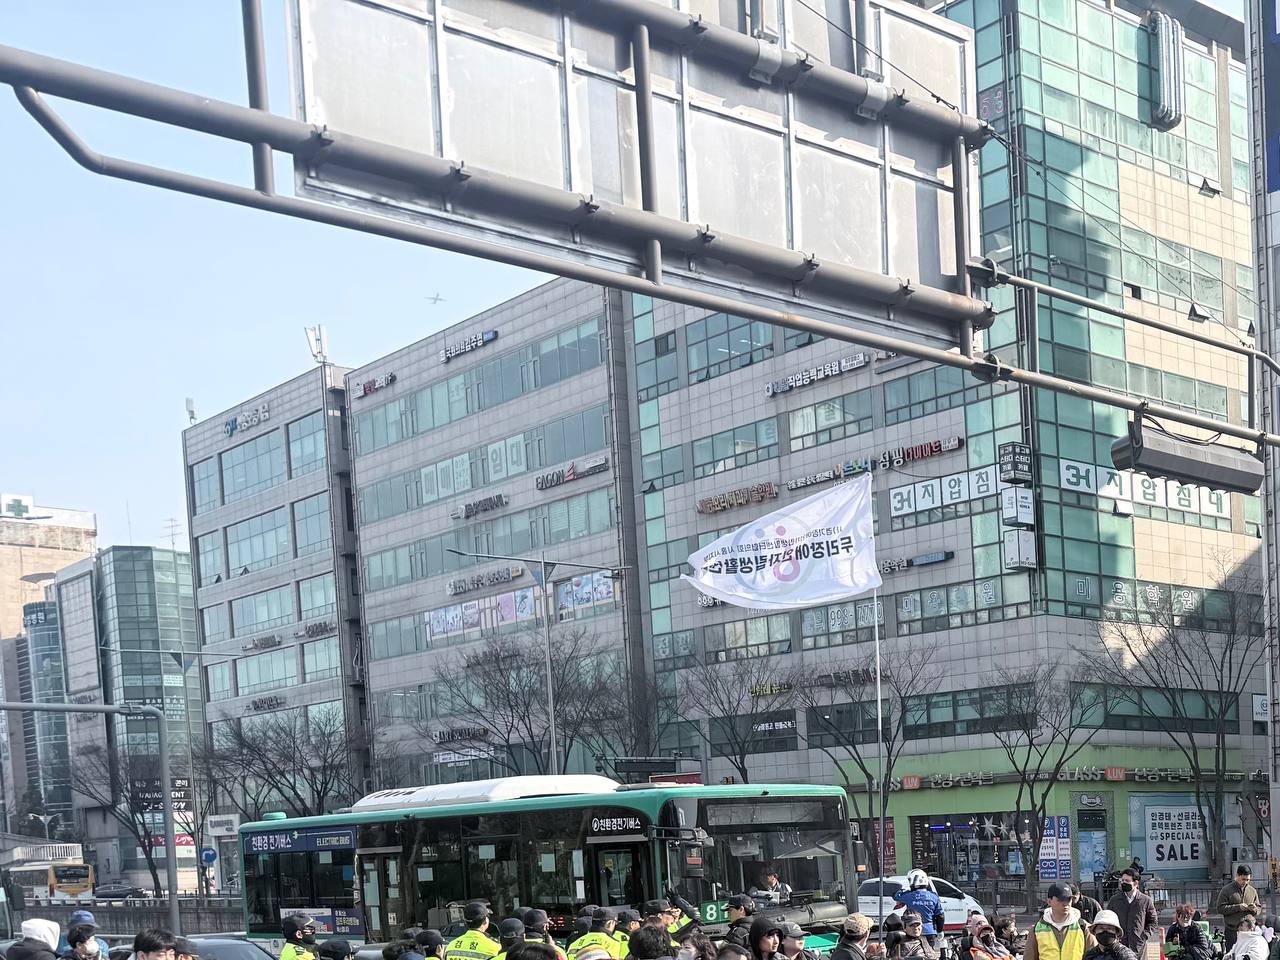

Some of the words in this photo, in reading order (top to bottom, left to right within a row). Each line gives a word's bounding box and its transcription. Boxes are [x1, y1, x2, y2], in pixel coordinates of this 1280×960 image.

[1057, 766, 1101, 781] GLASS
[1106, 768, 1125, 780] LUV
[903, 776, 920, 789] LUV
[599, 817, 641, 831] 친환경전기버스
[251, 835, 269, 851] 친환경
[269, 833, 292, 849] 전기버스
[316, 837, 340, 847] ELECTRIC
[340, 836, 350, 845] BUS
[1159, 831, 1196, 842] SPECIAL
[1155, 843, 1200, 863] SALE
